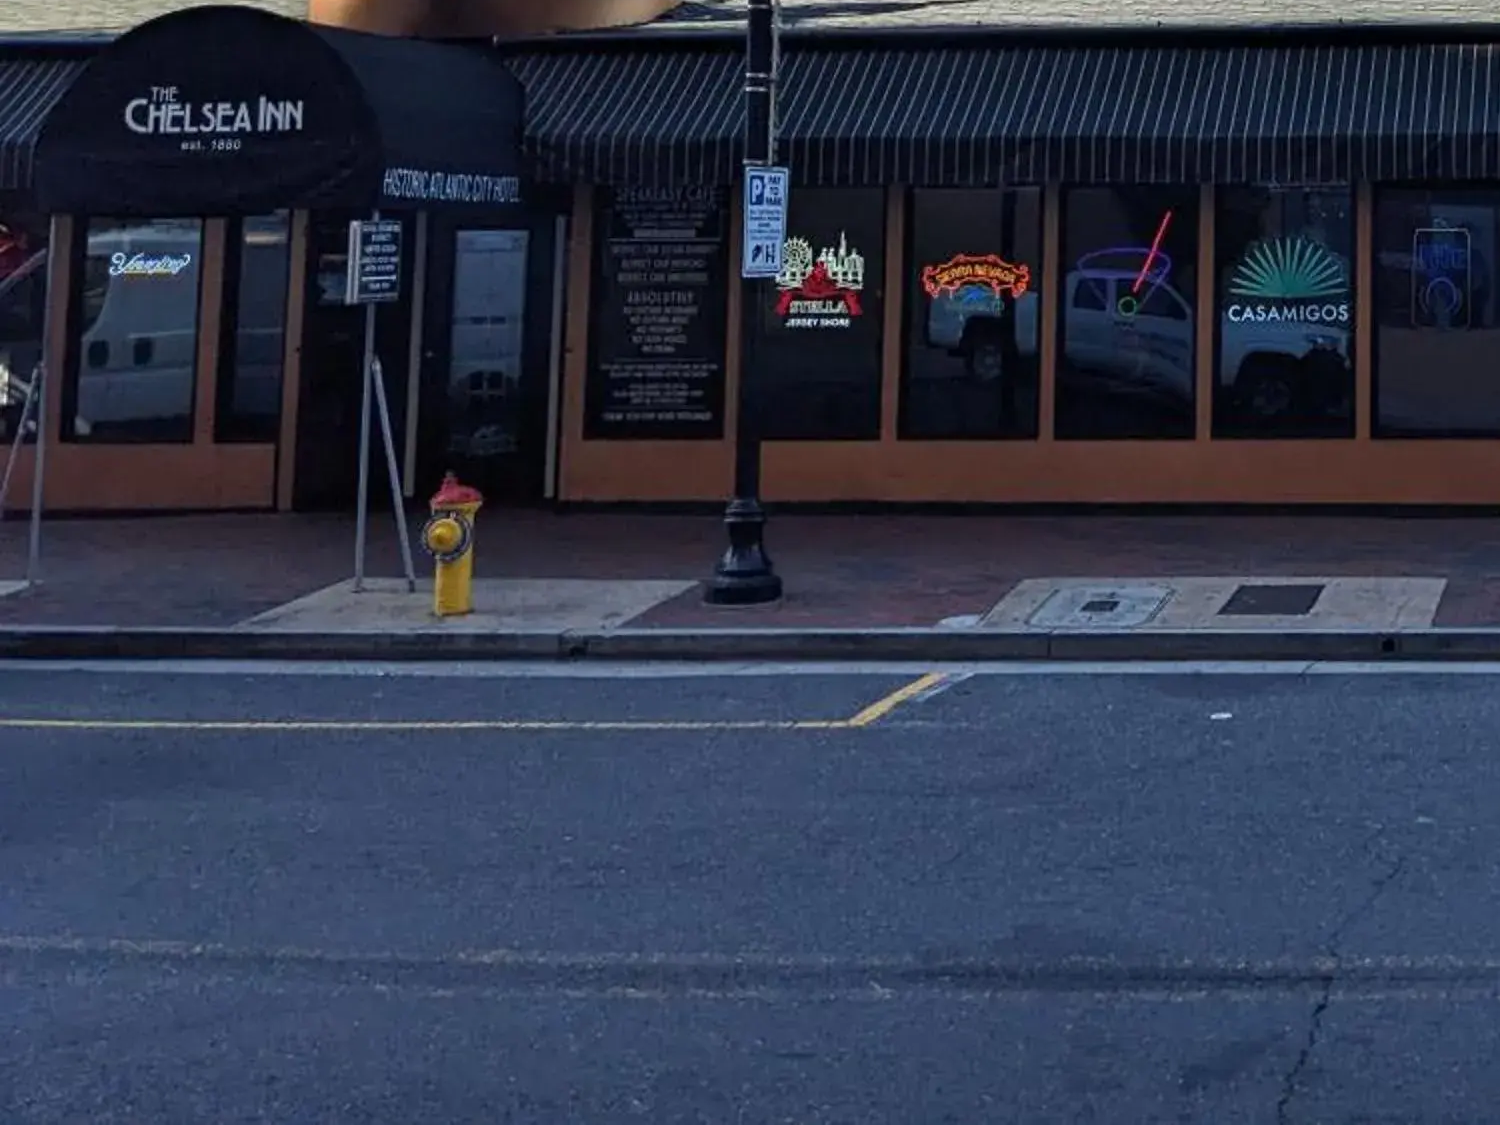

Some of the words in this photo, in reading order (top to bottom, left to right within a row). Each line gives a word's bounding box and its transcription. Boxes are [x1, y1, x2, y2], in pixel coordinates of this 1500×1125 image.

[151, 86, 178, 102] THE
[125, 98, 252, 134] CHELSEA
[257, 95, 304, 132] INN
[1228, 304, 1349, 322] CASAMIGOS
